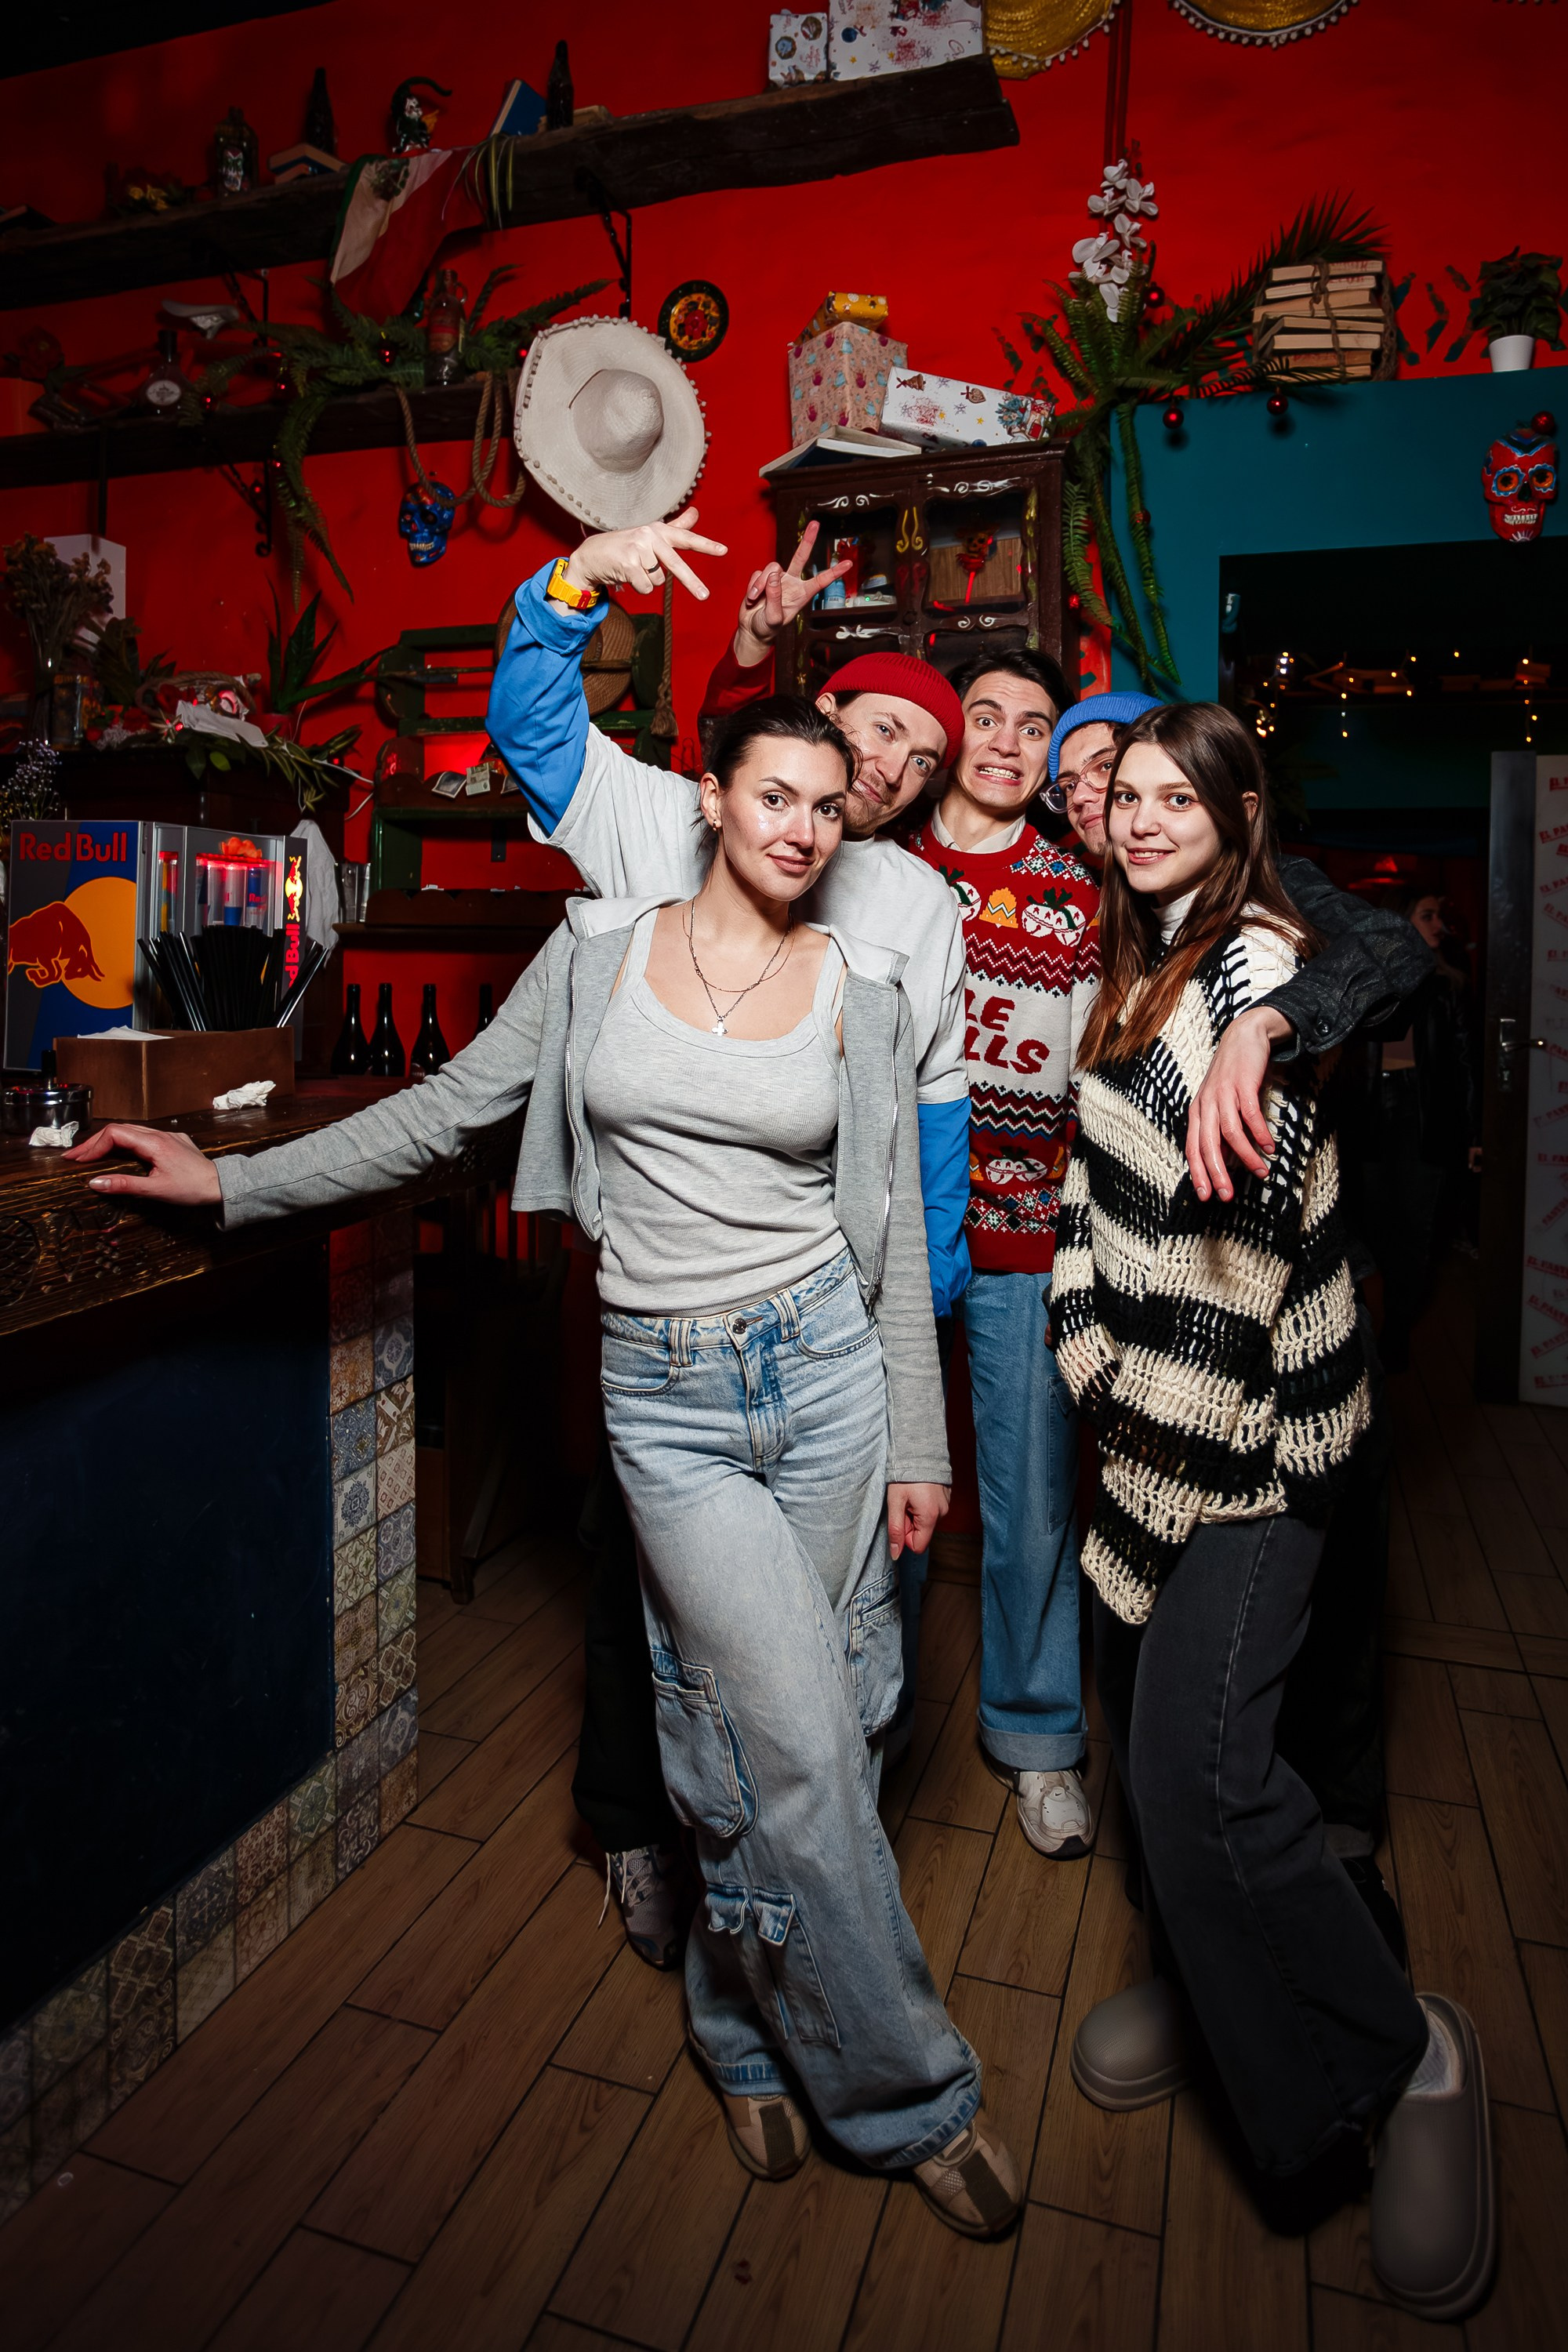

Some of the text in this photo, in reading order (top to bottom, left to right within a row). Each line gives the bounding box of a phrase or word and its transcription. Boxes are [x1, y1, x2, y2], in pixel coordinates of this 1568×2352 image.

[20, 832, 127, 862] Red Bull
[285, 924, 300, 963] Bull
